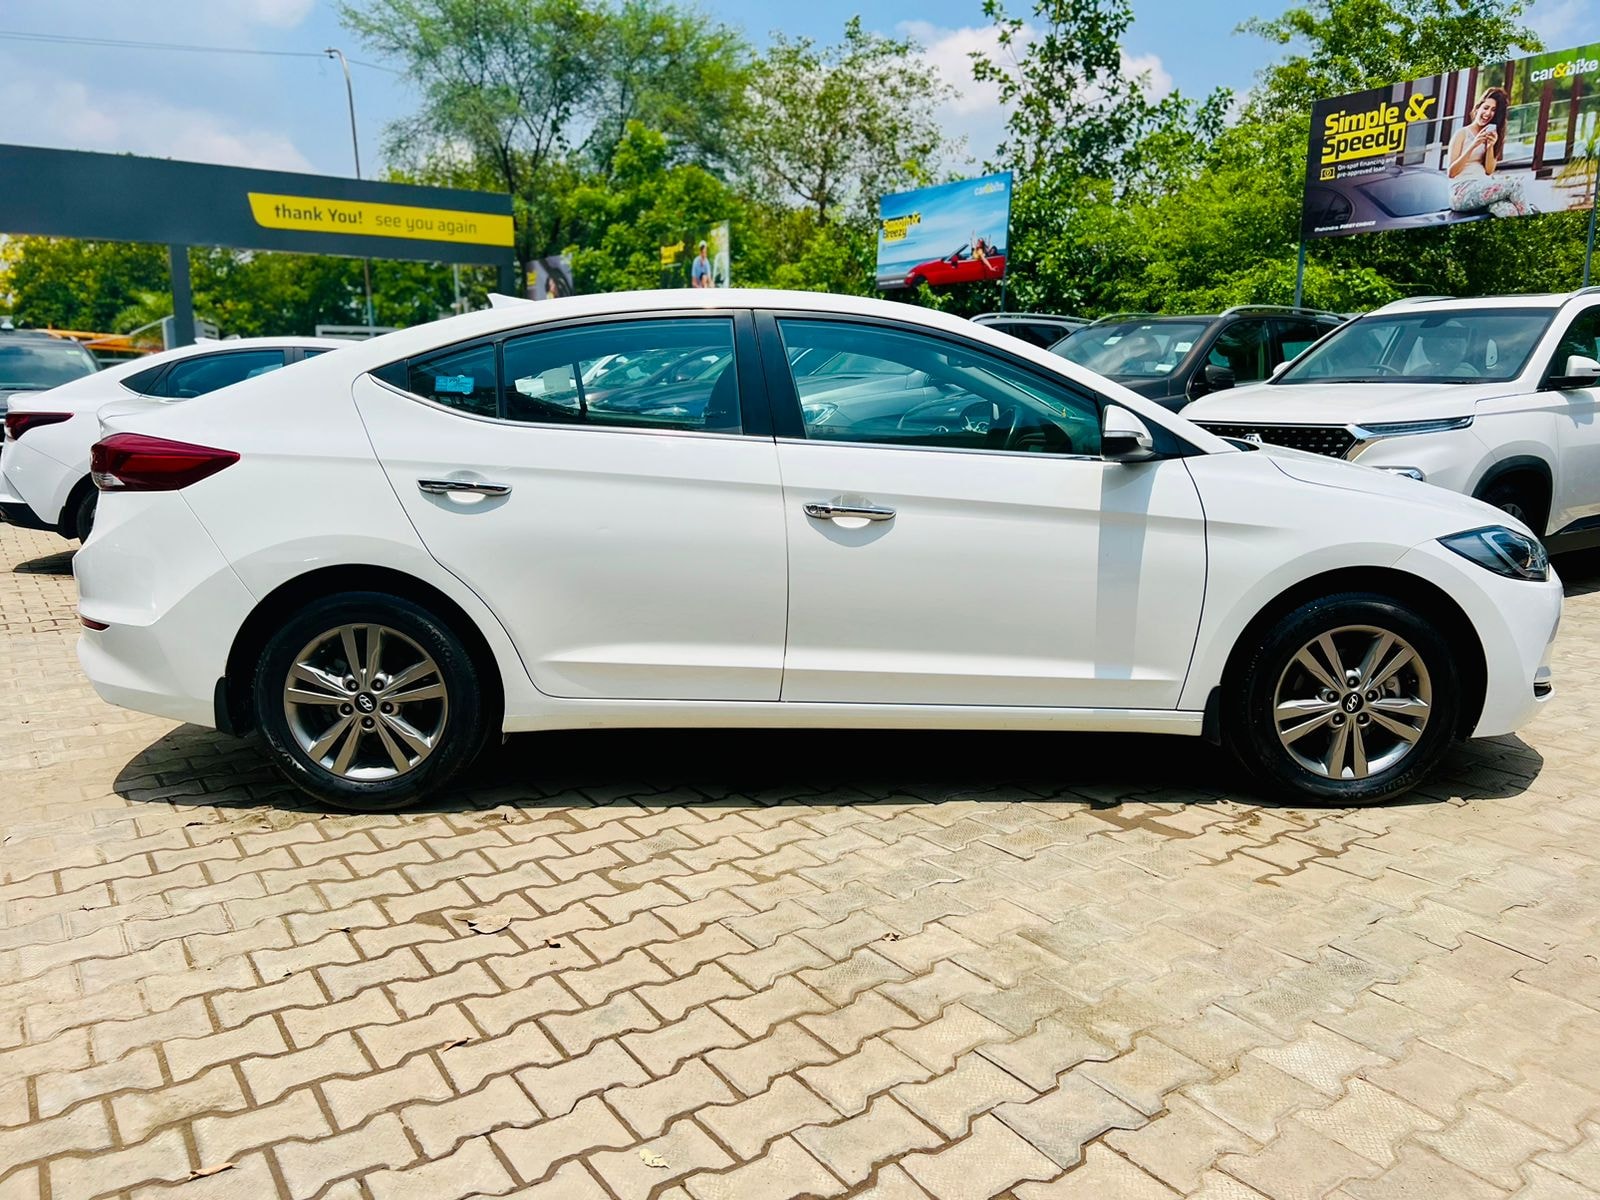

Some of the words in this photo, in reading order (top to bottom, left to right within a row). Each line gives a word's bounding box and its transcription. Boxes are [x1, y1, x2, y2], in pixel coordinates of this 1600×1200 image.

[1531, 58, 1599, 82] car&bike
[1324, 102, 1400, 136] Simple
[1404, 93, 1436, 122] &
[1322, 125, 1403, 160] Speedy
[1337, 167, 1372, 179] pre-approved
[1338, 162, 1359, 171] On-spot
[1360, 158, 1385, 167] financing
[274, 204, 323, 221] thank
[327, 208, 363, 225] You!
[375, 215, 401, 228] see
[405, 217, 433, 233] you
[438, 219, 478, 236] again
